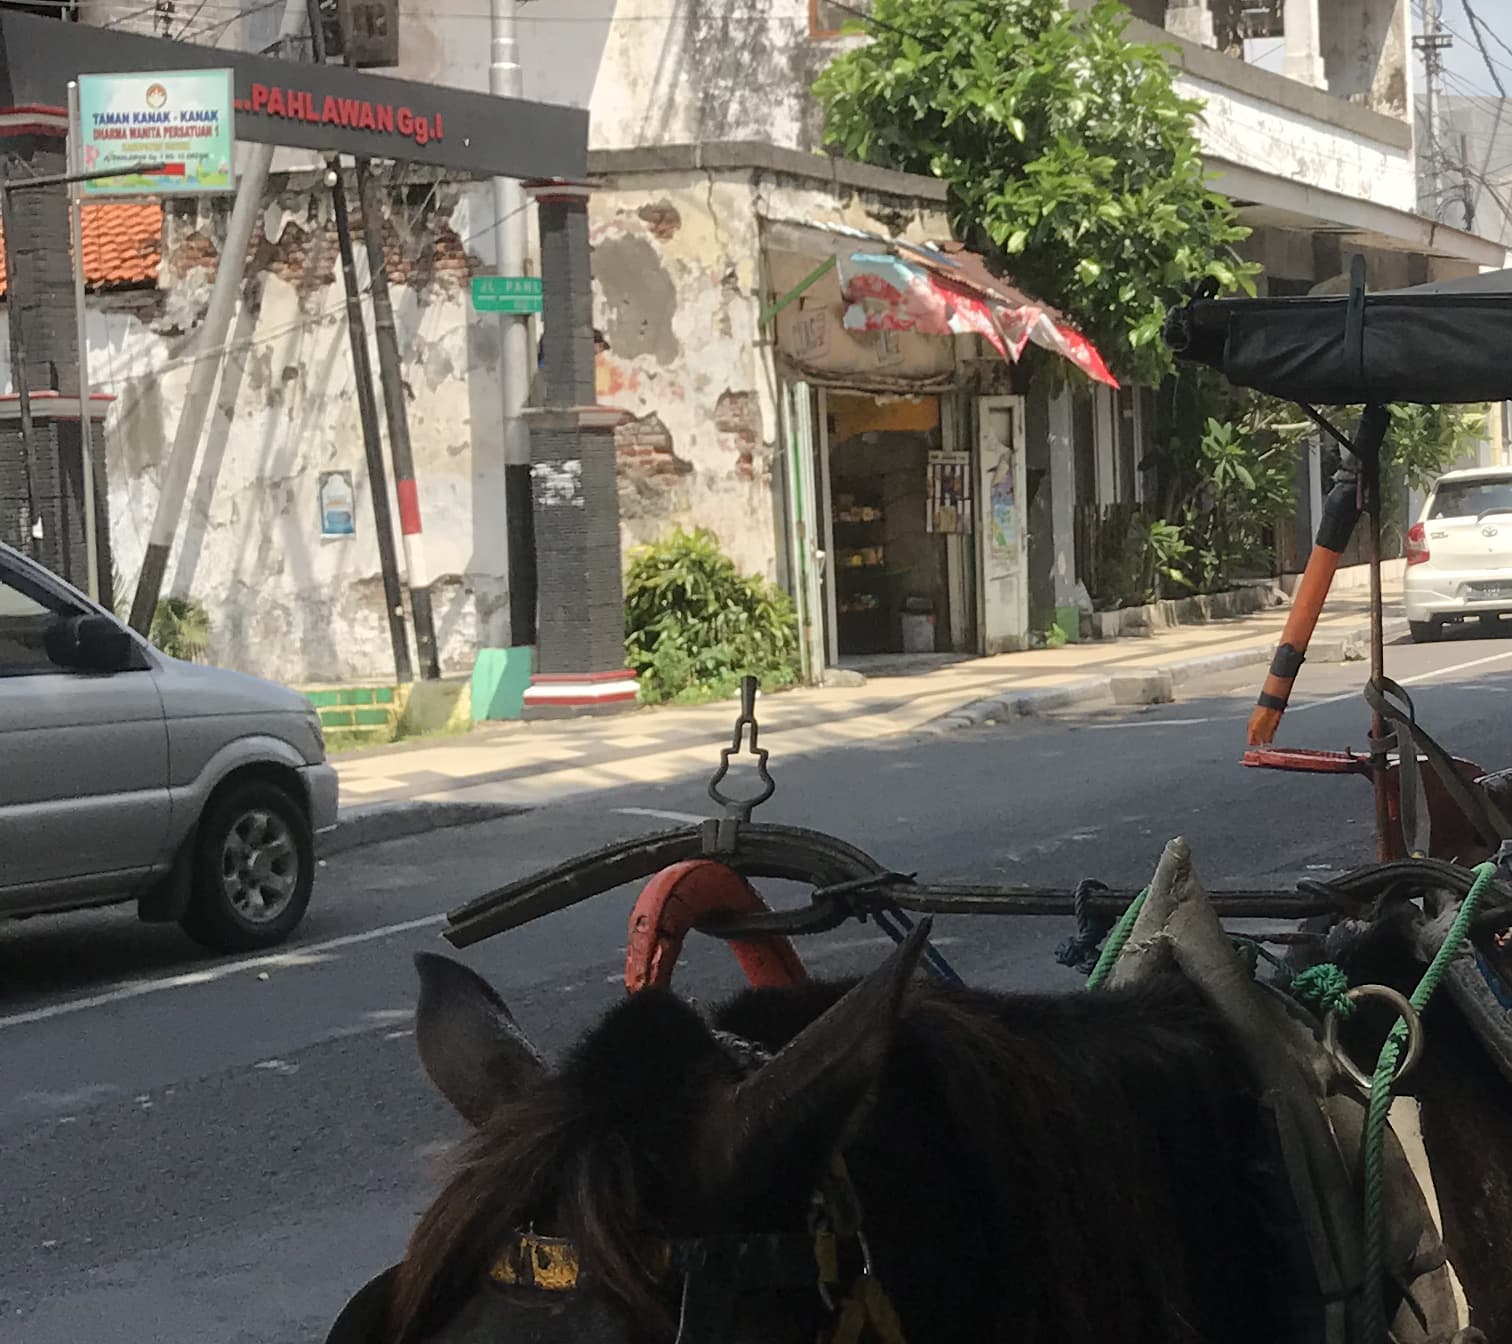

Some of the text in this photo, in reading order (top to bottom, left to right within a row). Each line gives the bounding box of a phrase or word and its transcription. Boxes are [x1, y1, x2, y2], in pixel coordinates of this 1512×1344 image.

[92, 112, 130, 125] TAMAN
[132, 111, 171, 124] KANAK
[180, 109, 219, 123] KANAK
[93, 127, 128, 140] DHARMA
[163, 125, 213, 139] PERSATUAN
[505, 281, 541, 293] PAHL
